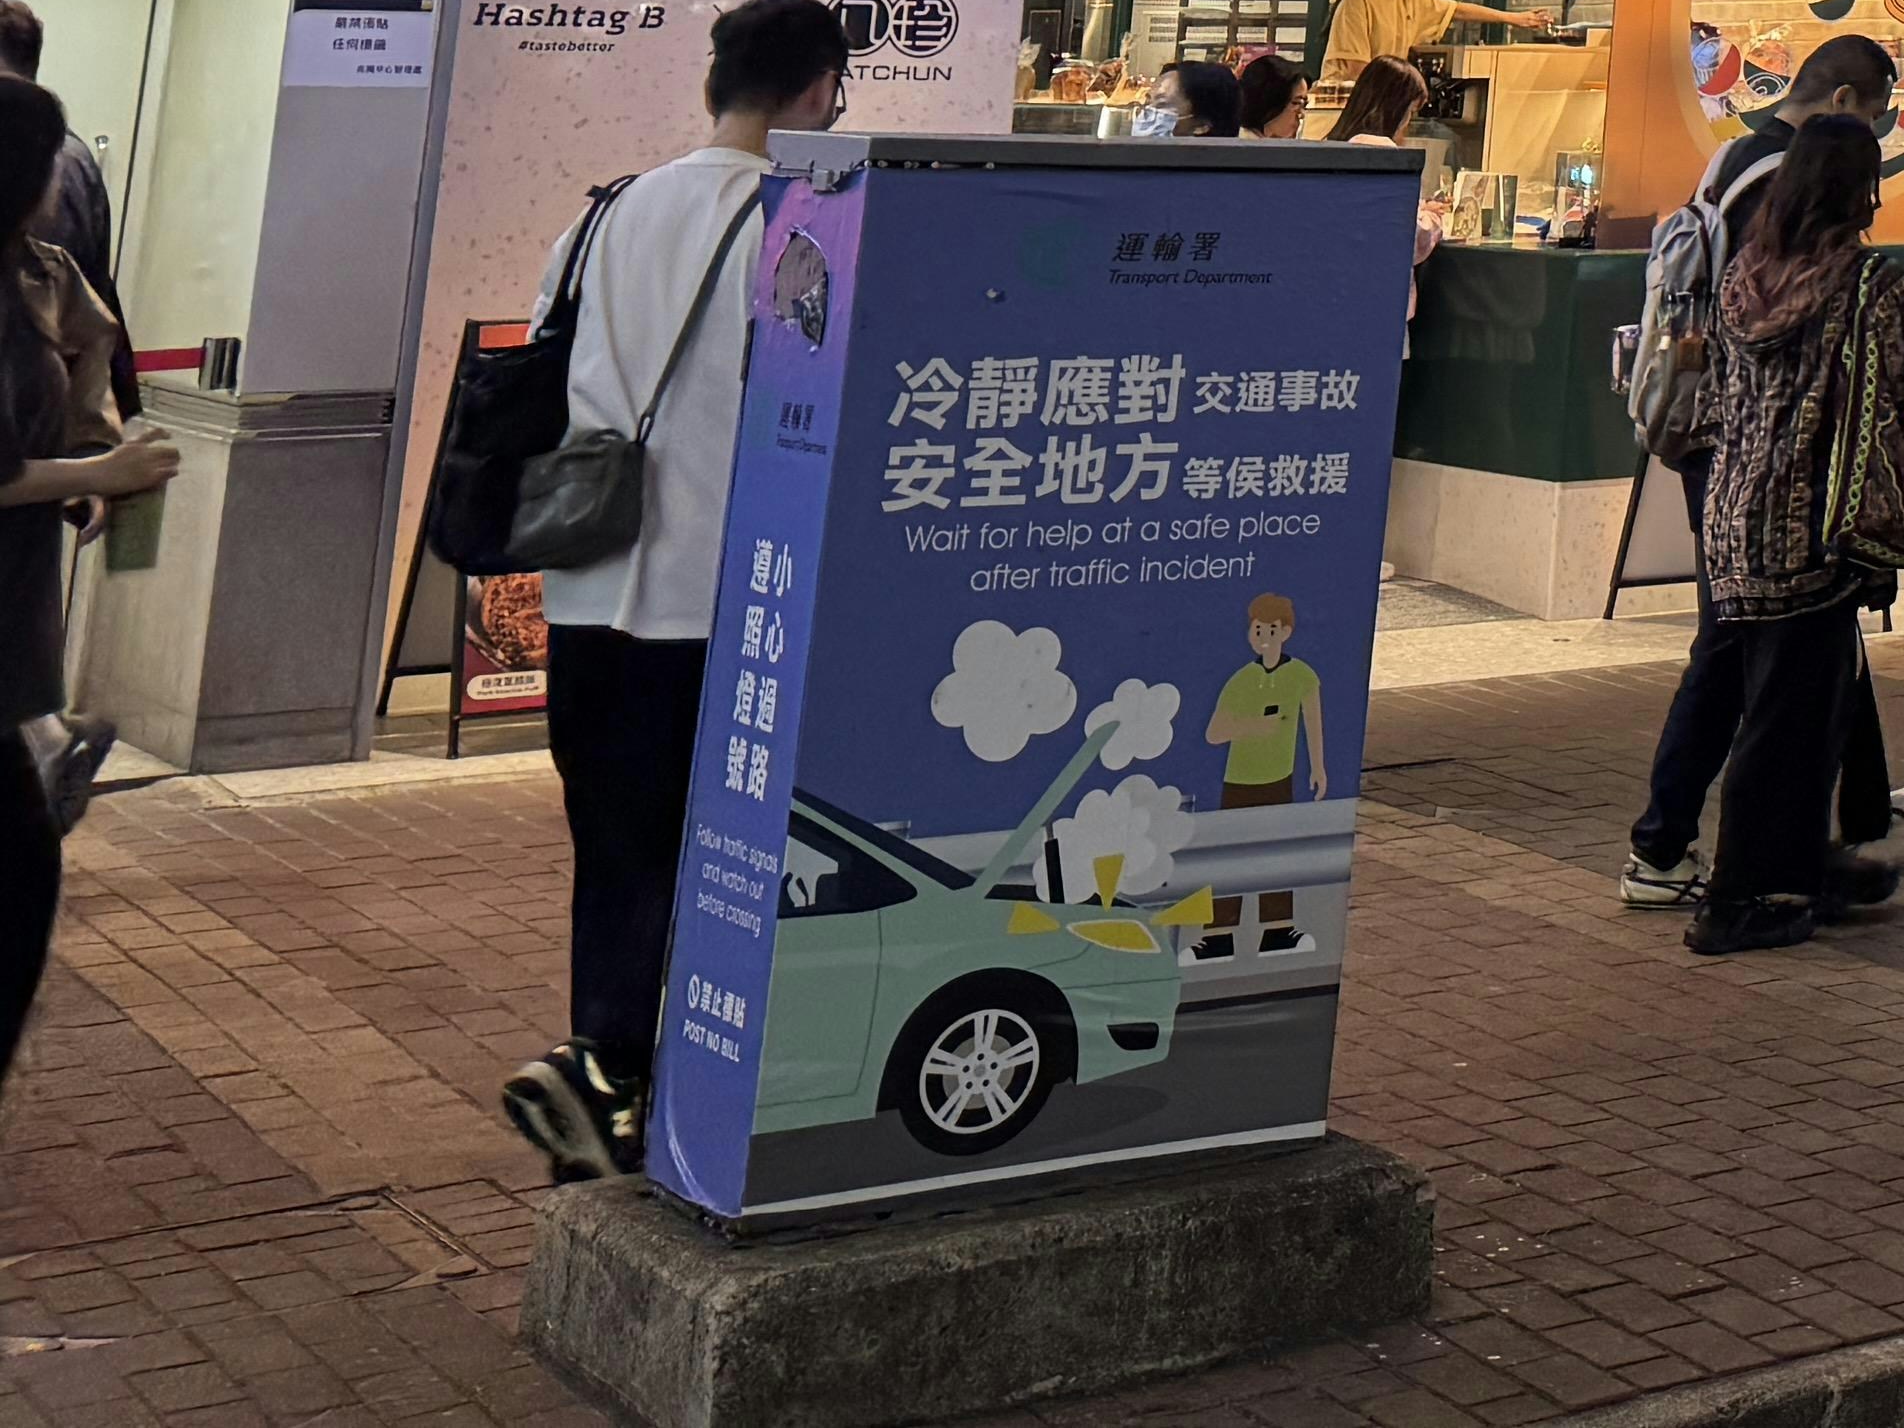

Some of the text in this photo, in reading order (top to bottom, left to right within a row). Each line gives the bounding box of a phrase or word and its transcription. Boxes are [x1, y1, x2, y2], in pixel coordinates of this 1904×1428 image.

[473, 2, 666, 36] Hashtag B
[839, 64, 953, 82] ATCHUN
[1112, 231, 1222, 263] 運輸署
[1109, 269, 1274, 287] Transport Department
[888, 353, 1361, 431] 冷靜應對 交通事故
[880, 435, 1180, 513] 安全地方
[903, 510, 1322, 557] Wait for help at a safe place
[969, 551, 1256, 593] after traffic incident
[725, 538, 774, 792] 遵照燈號
[696, 824, 778, 875] Follow traffic signals
[702, 861, 720, 882] and
[721, 868, 748, 893] watch
[697, 890, 762, 938] before crossing
[683, 1018, 706, 1045] POST
[721, 1038, 741, 1063] BILL
